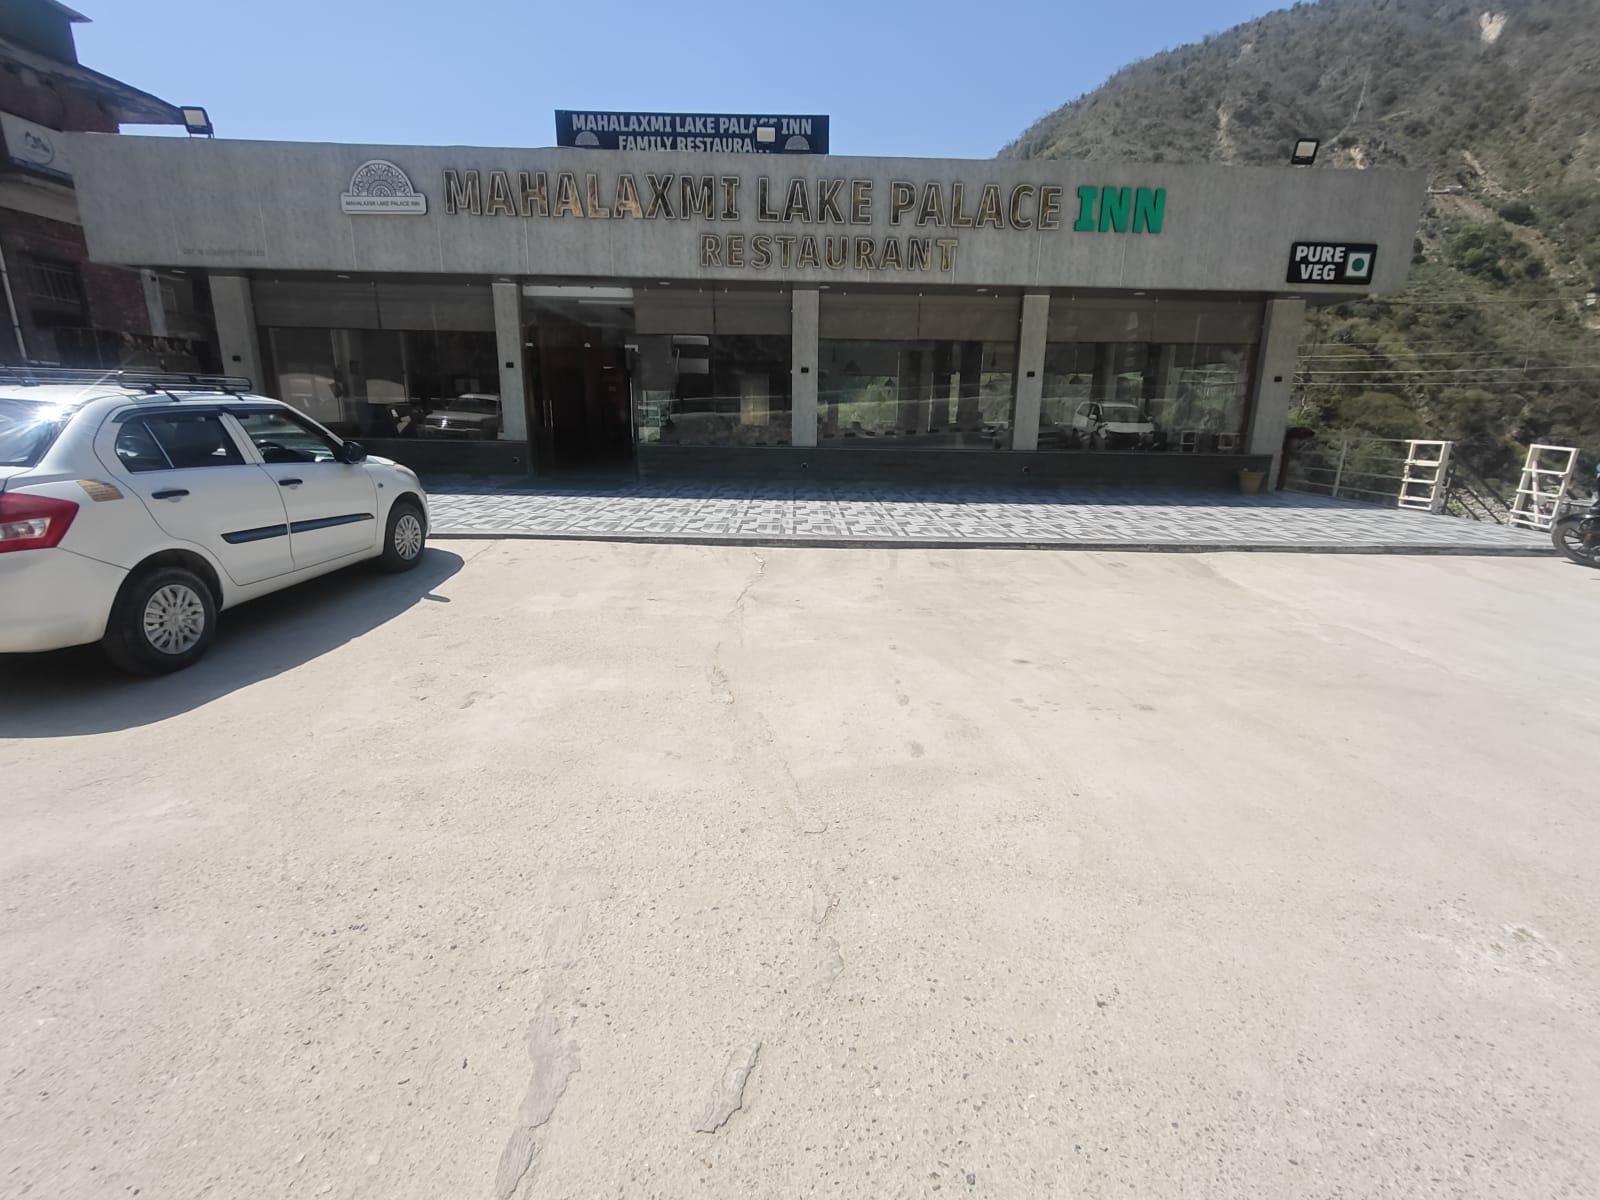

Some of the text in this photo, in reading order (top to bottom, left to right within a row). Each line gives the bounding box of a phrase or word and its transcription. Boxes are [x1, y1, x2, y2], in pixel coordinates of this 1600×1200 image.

[572, 114, 672, 132] MAHALAXMI
[676, 116, 715, 133] LAKE
[781, 119, 812, 135] INN
[619, 135, 770, 153] FAMILY RESTAURA
[443, 169, 1166, 234] MAHALAXMI LAKE PALACE INN
[700, 234, 959, 272] RESTAURANT
[1295, 245, 1346, 263] PURE
[1300, 263, 1336, 280] VEG
